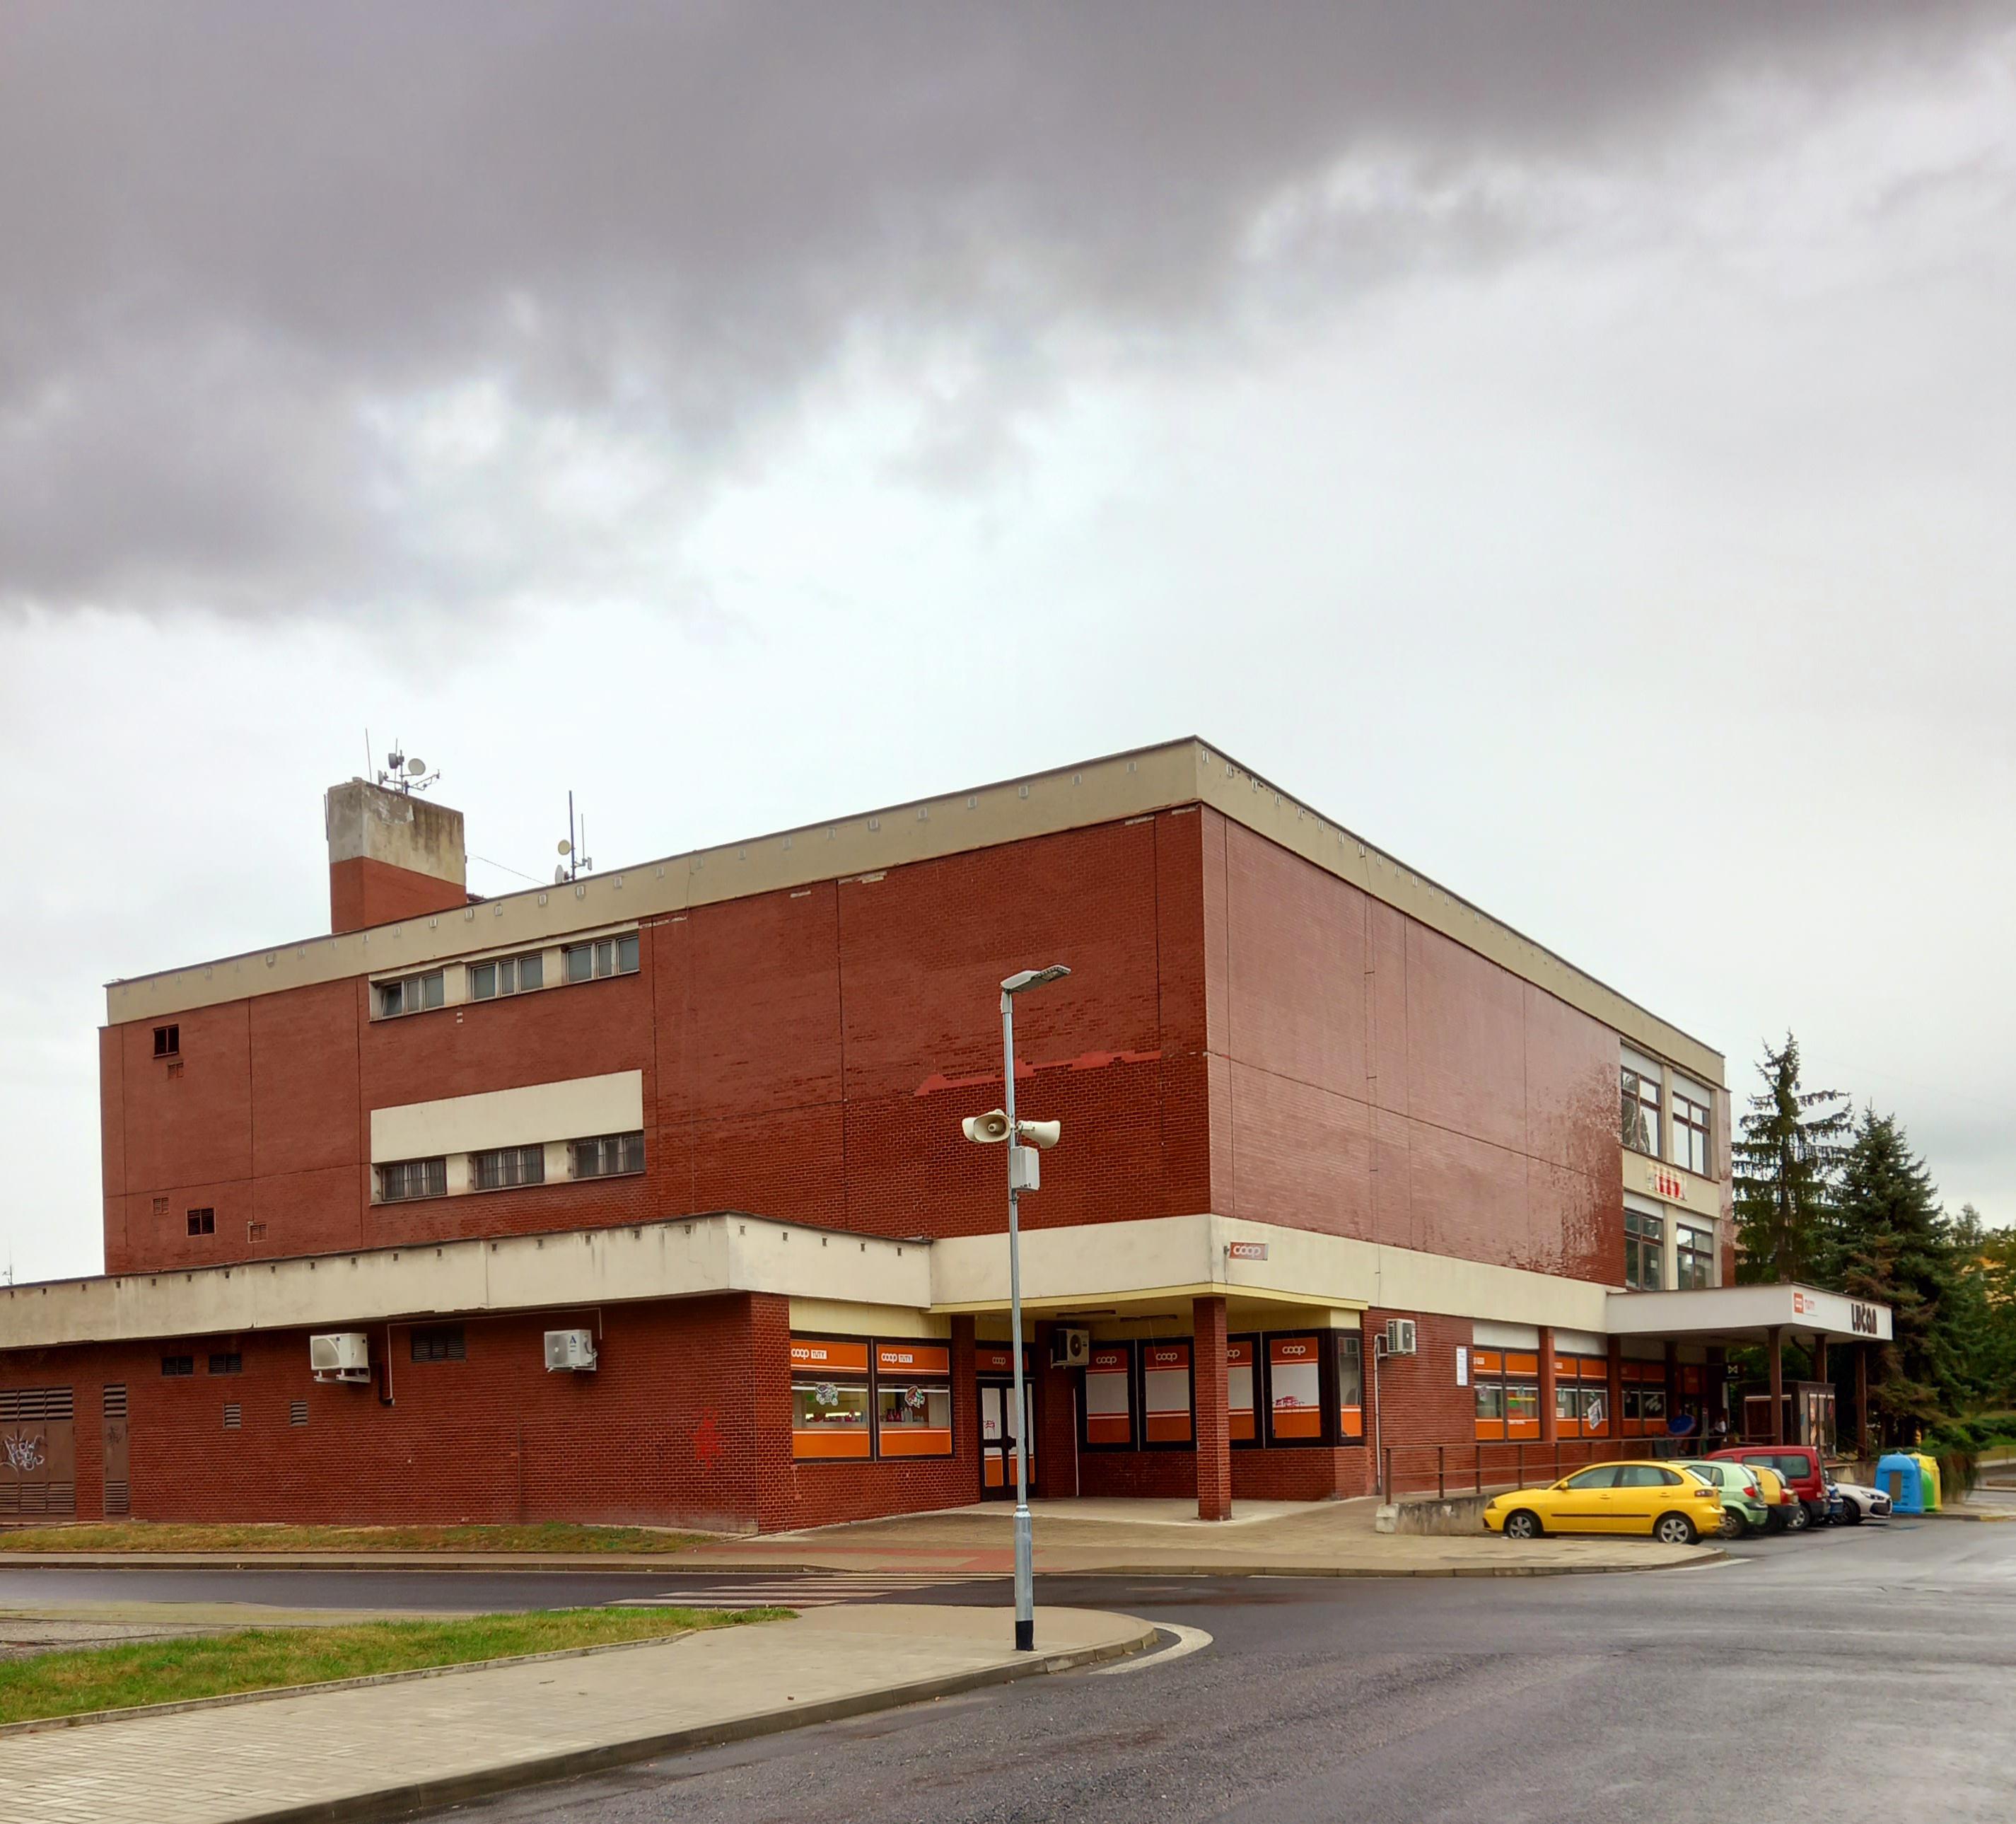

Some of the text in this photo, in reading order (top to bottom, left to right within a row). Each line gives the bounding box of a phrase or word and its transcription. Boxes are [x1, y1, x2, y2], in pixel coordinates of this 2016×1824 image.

[1233, 1245, 1261, 1257] coop
[791, 1348, 810, 1360] coop
[1282, 1345, 1306, 1356] coop
[881, 1353, 897, 1364] coop
[992, 1357, 1006, 1366] coop
[1096, 1356, 1117, 1365] coop
[1155, 1352, 1177, 1362] coop
